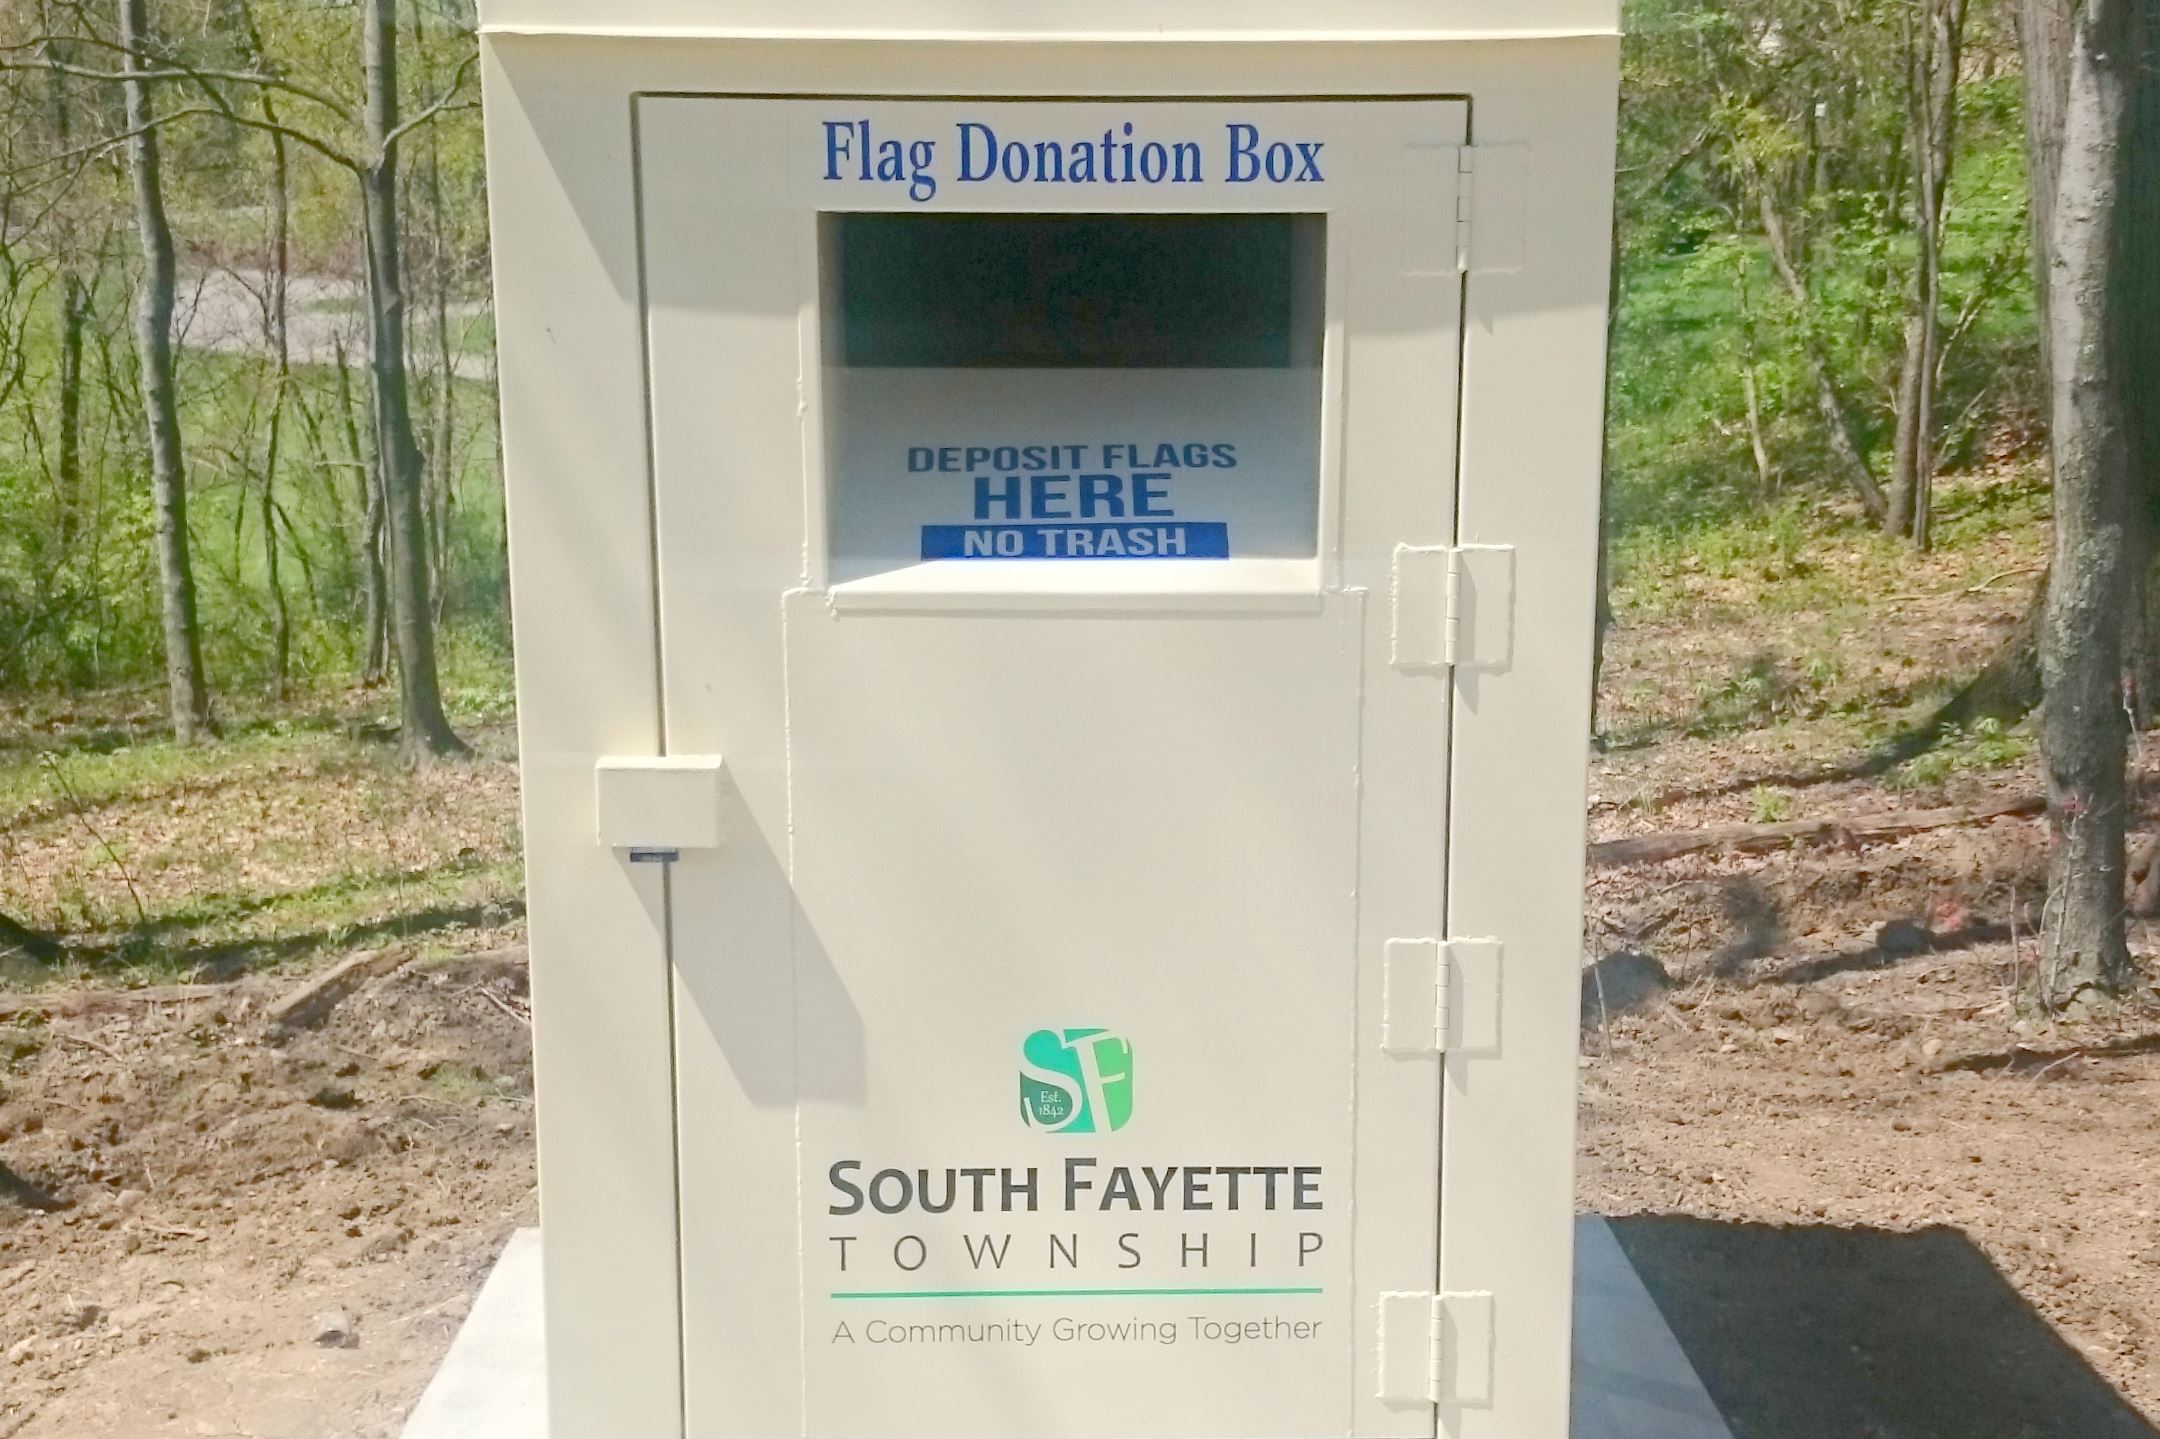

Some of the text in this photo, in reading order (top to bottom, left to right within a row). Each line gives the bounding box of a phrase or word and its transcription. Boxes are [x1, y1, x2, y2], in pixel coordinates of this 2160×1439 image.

[822, 119, 1325, 202] Flag Donation Box
[907, 443, 1237, 472] DEPOSIT FLAGS
[974, 473, 1174, 520] HERE
[963, 527, 1186, 557] NO TRASH
[828, 1157, 1323, 1215] SOUTH FAYETTE
[829, 1232, 1324, 1272] TOWNSHIP
[832, 1315, 1322, 1346] A Community Growing Together
